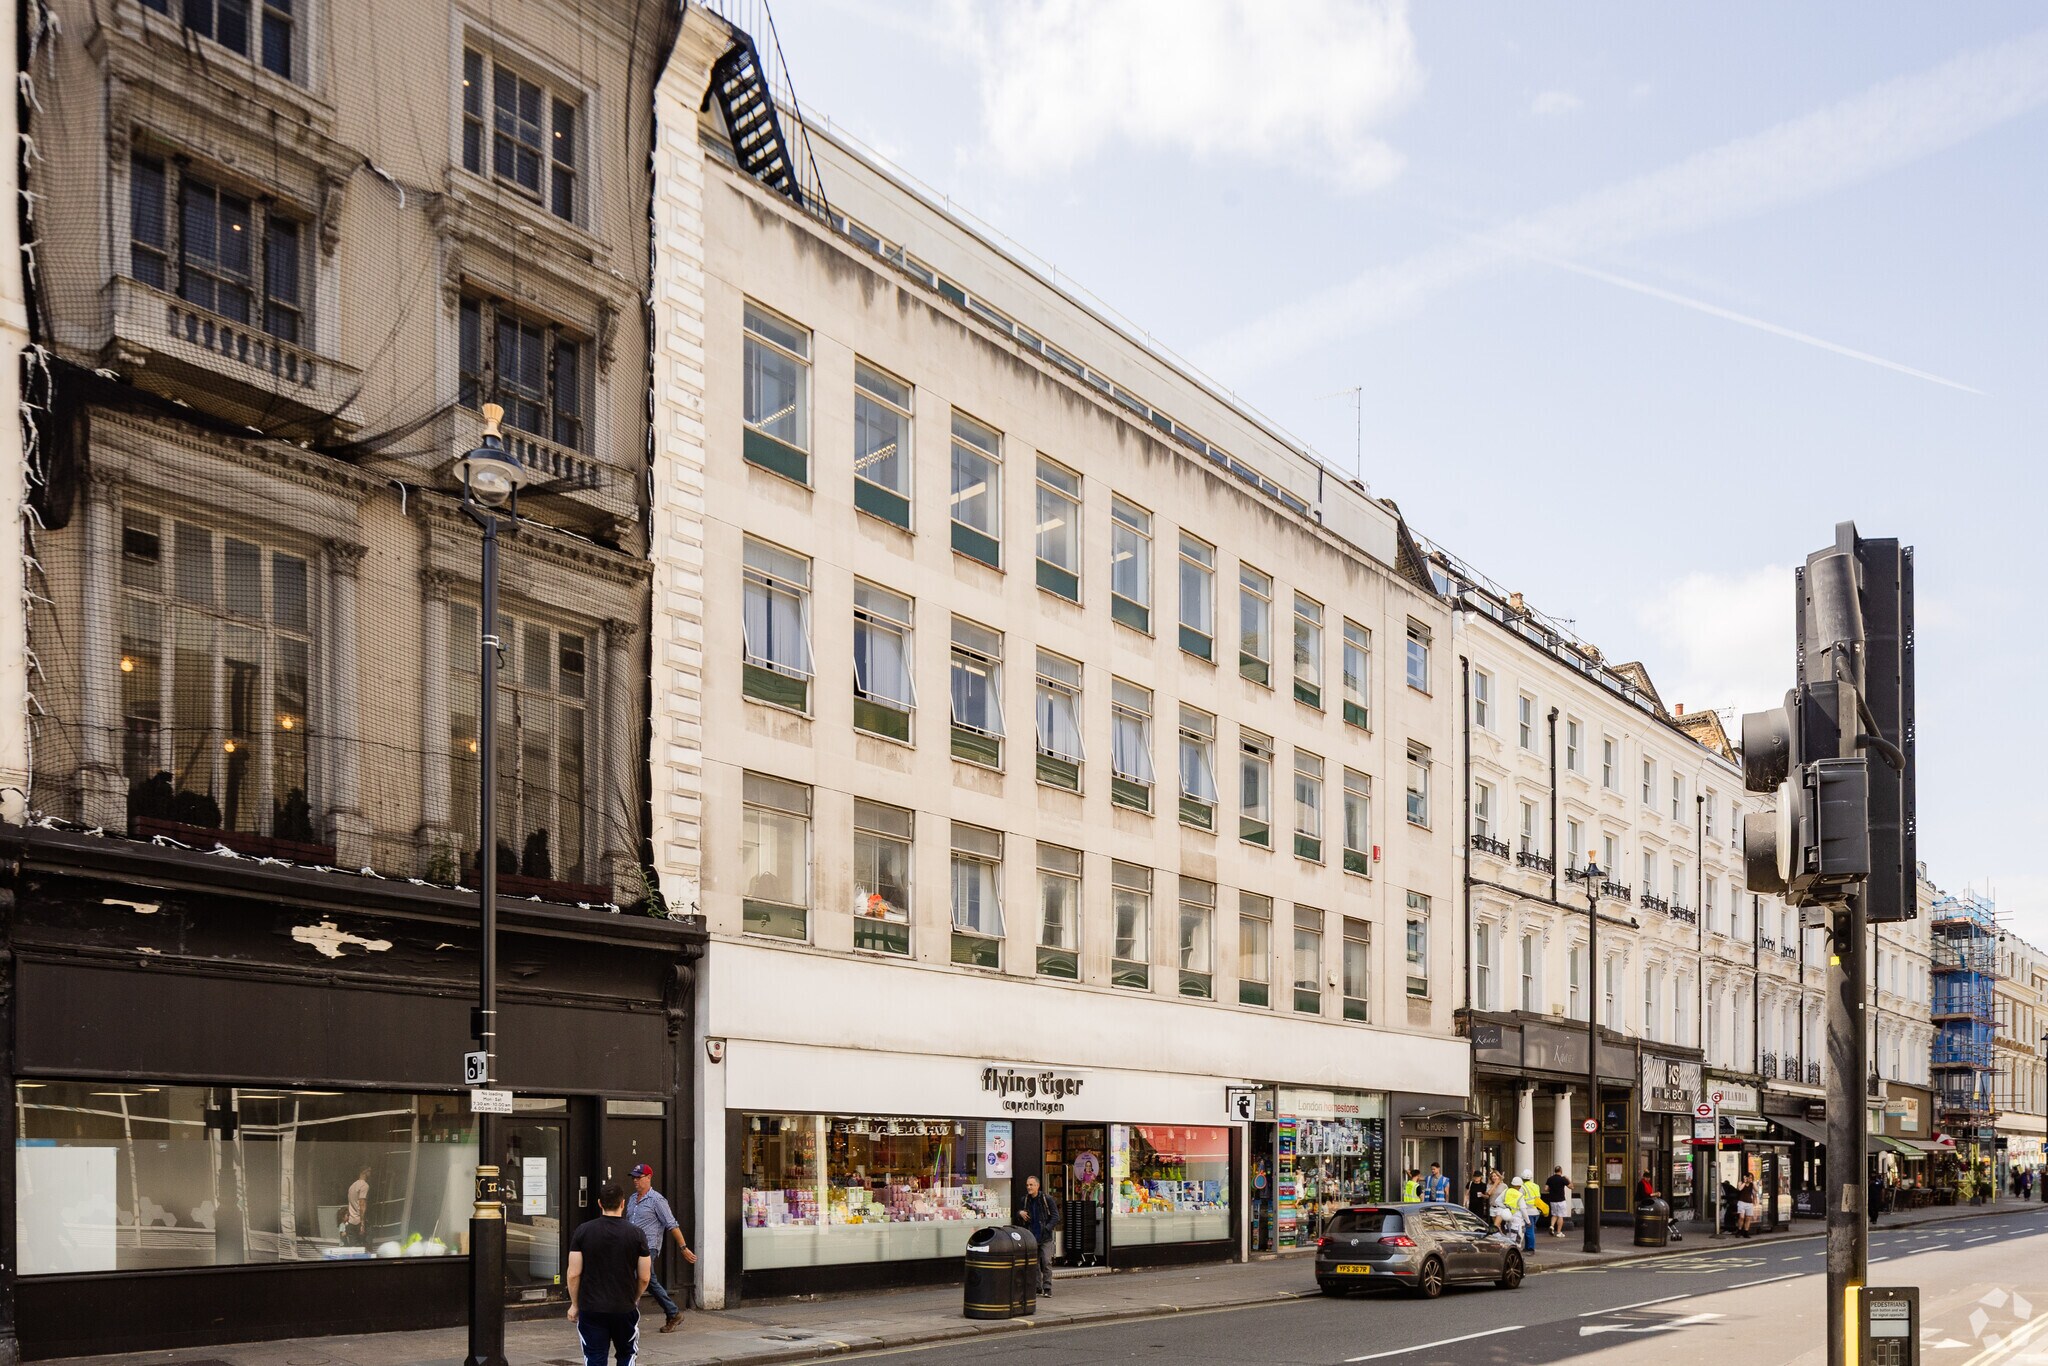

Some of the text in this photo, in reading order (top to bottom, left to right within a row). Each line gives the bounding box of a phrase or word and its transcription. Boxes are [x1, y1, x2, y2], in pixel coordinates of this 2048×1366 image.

[981, 1068, 1084, 1100] flying tiger
[1003, 1099, 1065, 1115] copenhagen
[1298, 1099, 1360, 1114] London homestores
[1416, 1123, 1448, 1132] KING HOUSE
[1585, 1122, 1595, 1130] 20
